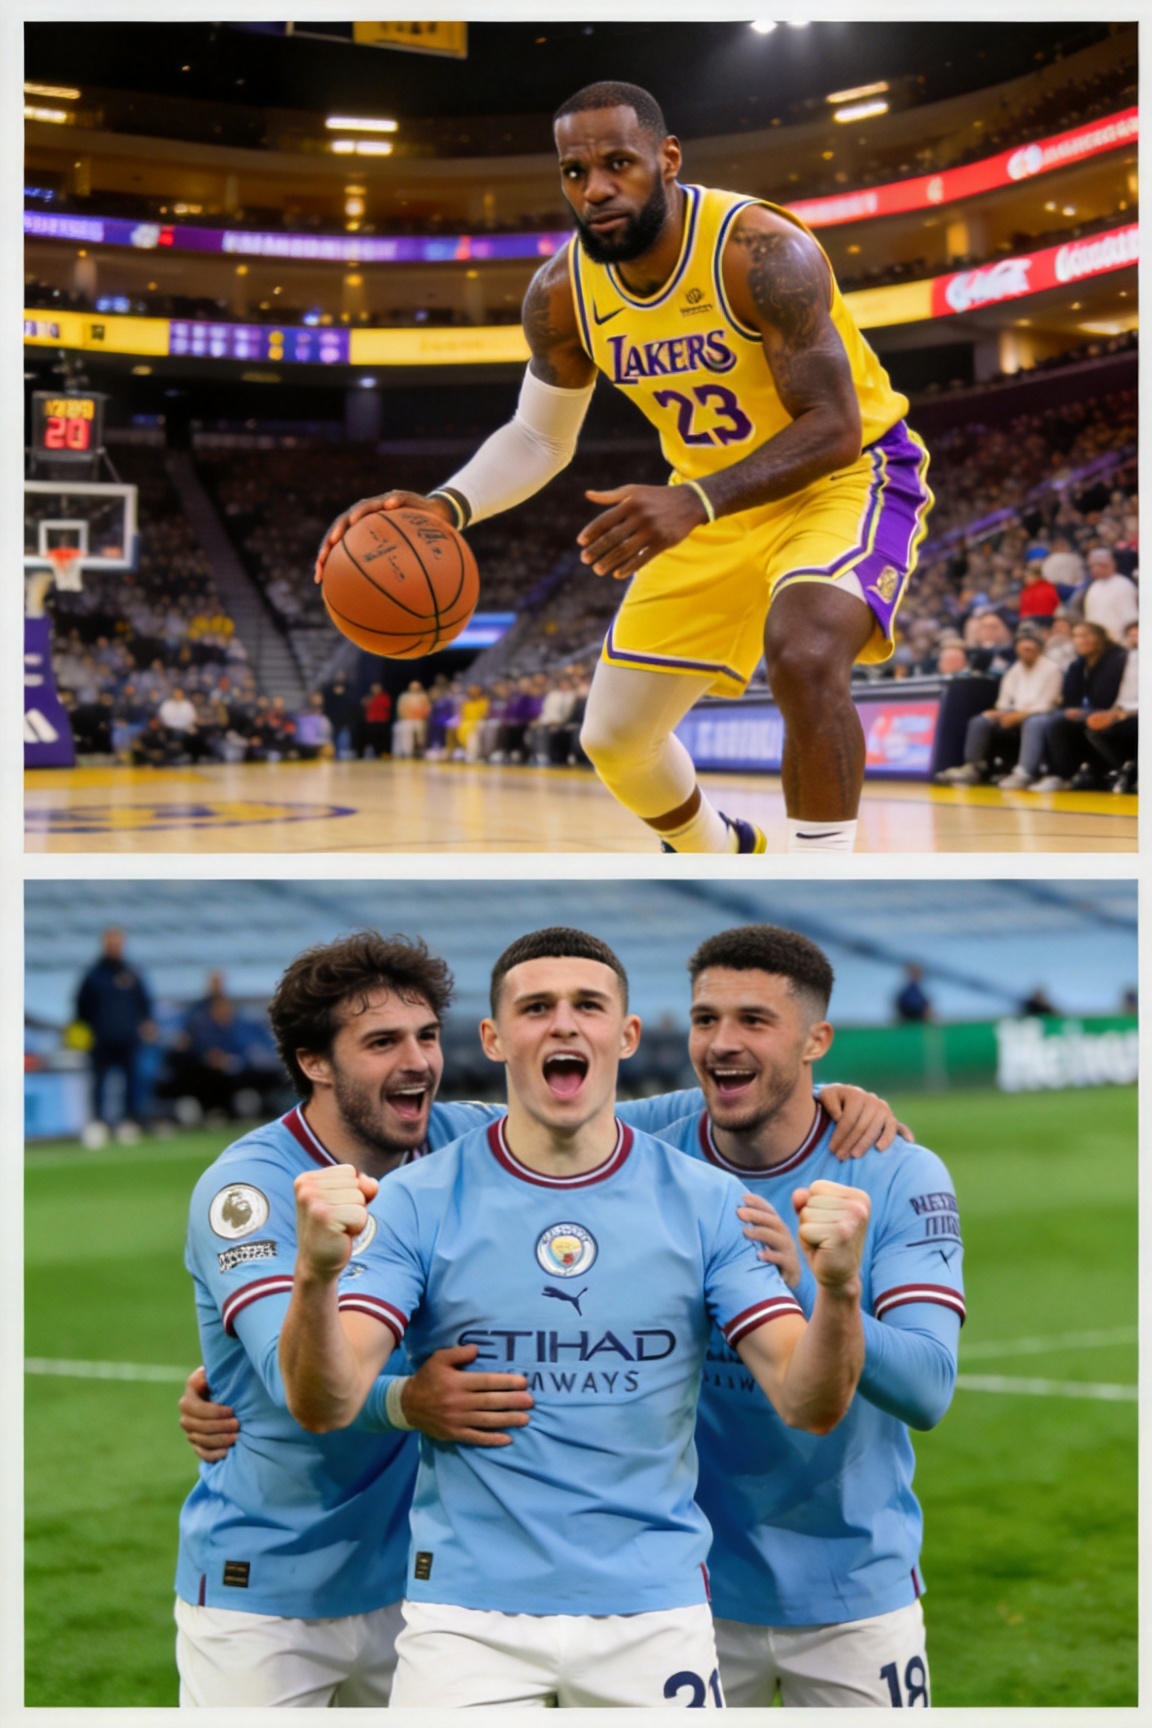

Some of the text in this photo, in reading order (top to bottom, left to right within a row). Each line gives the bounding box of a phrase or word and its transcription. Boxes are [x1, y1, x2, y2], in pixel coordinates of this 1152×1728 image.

[607, 330, 737, 385] LAKERS
[44, 416, 91, 450] 20
[652, 384, 753, 446] 23
[457, 1329, 677, 1363] ETIHAD
[506, 1368, 640, 1395] WAYS
[879, 1655, 929, 1708] 18
